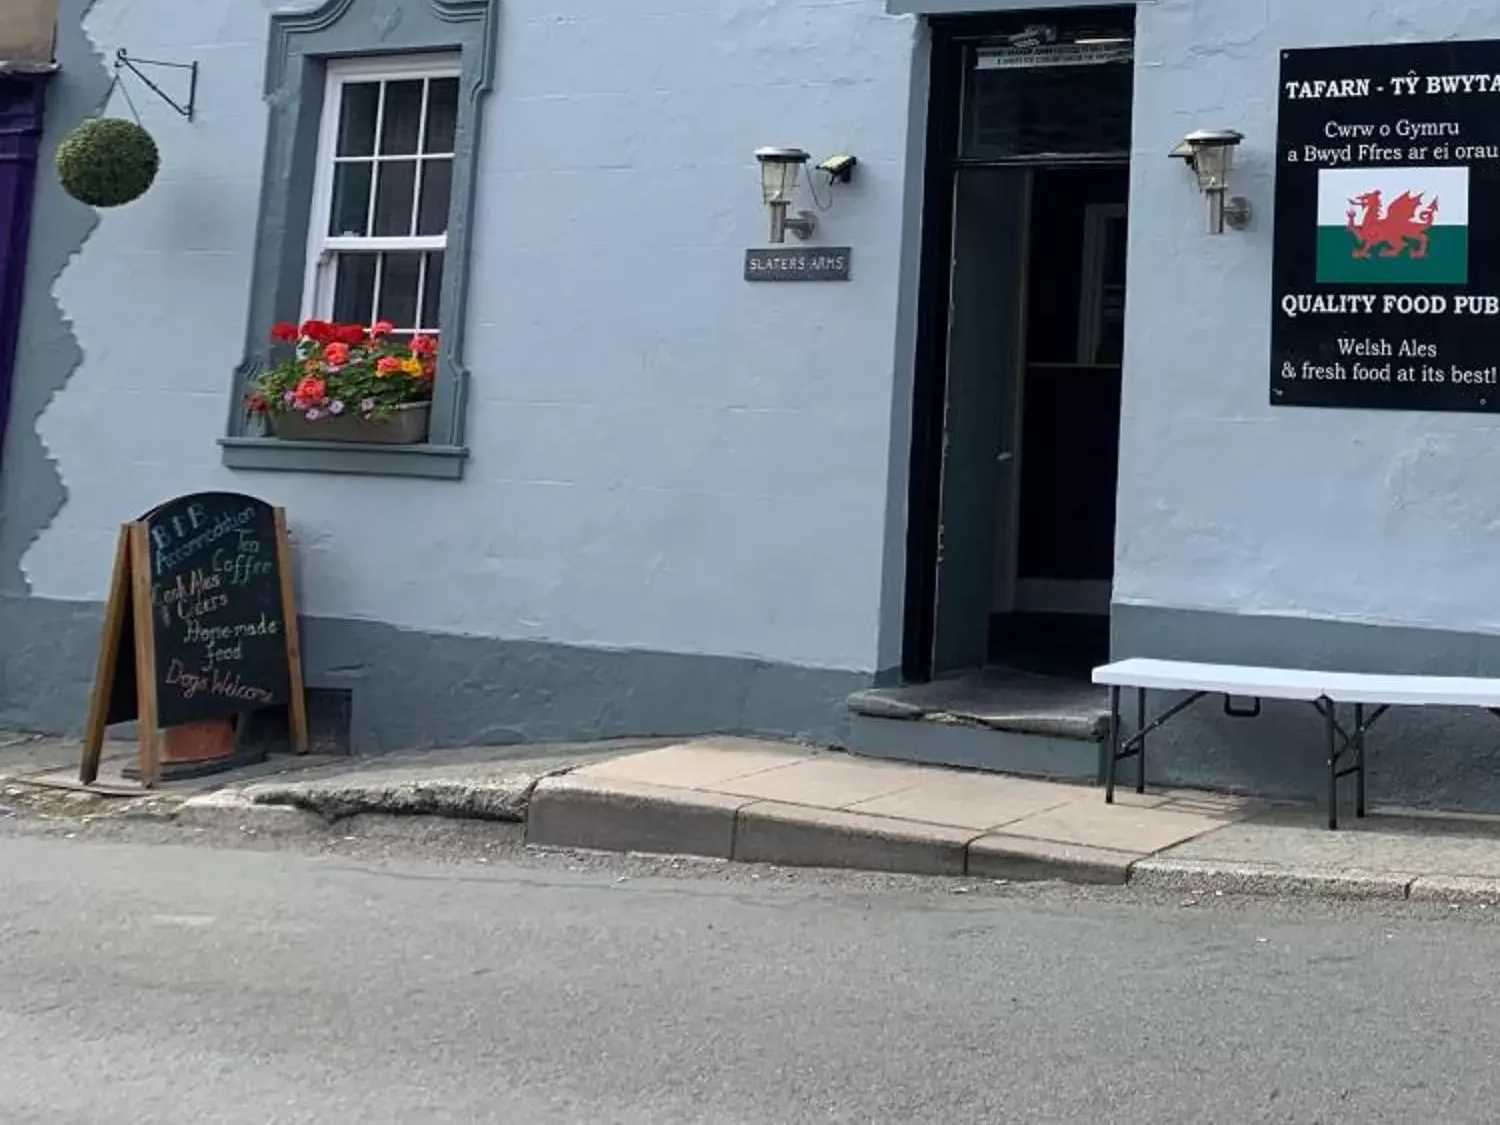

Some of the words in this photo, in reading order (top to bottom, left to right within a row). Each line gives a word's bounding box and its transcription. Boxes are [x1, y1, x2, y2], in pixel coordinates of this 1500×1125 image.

[1286, 79, 1370, 99] TAFARN
[1325, 122, 1374, 137] Cwrw
[1380, 125, 1390, 136] o
[1396, 119, 1459, 139] Gymru
[1288, 151, 1298, 161] a
[1304, 146, 1352, 166] Bwyd
[1359, 143, 1402, 160] Ffres
[1408, 147, 1427, 159] ar
[1434, 143, 1448, 159] ei
[1455, 146, 1498, 159] orau
[750, 257, 806, 270] SLATERS
[1282, 295, 1376, 317] QUALITY
[1383, 295, 1446, 313] FOOD
[1454, 296, 1499, 314] PUB
[1338, 339, 1392, 355] Welsh
[1399, 339, 1436, 357] Ales
[1282, 362, 1296, 378] &
[1302, 362, 1346, 379] fresh
[1353, 363, 1390, 381] food
[1397, 368, 1415, 381] at
[1422, 365, 1444, 382] its
[1452, 365, 1496, 383] best!
[236, 528, 260, 553] Tea
[212, 548, 272, 586] Coffee
[166, 659, 208, 700] Dogs
[211, 670, 273, 702] Welcome
